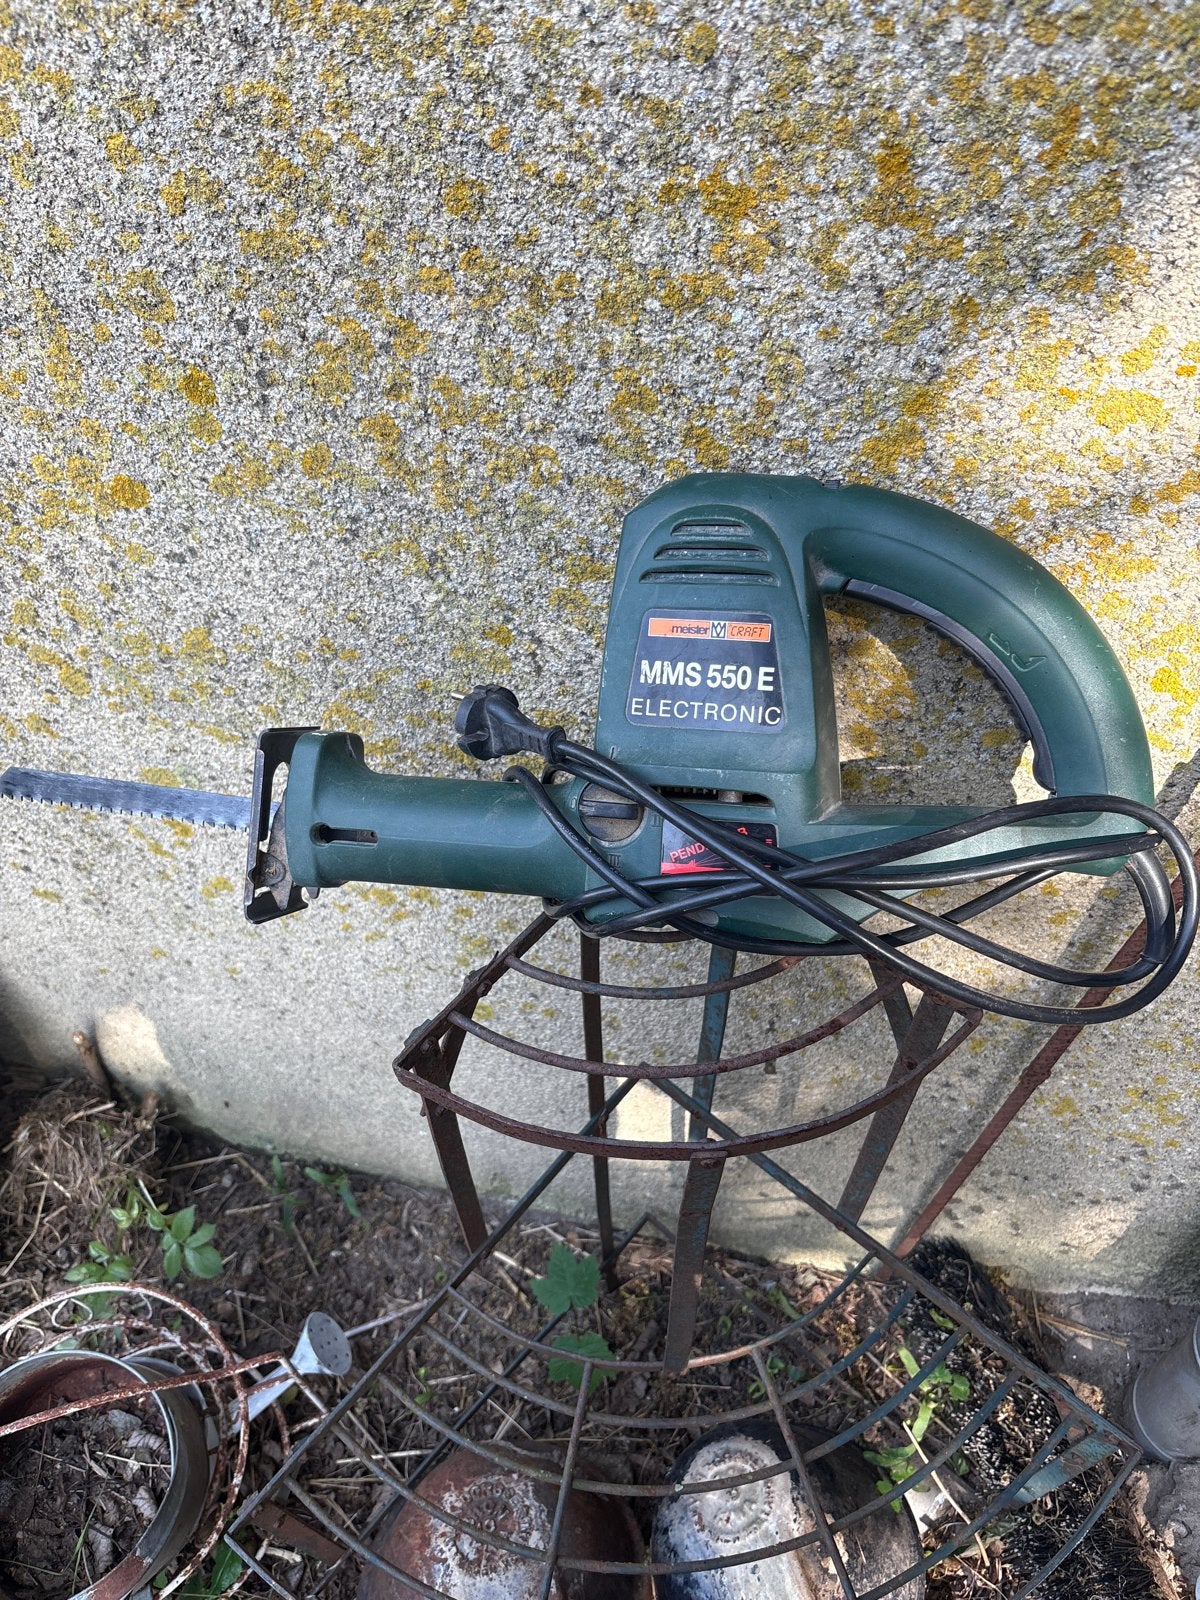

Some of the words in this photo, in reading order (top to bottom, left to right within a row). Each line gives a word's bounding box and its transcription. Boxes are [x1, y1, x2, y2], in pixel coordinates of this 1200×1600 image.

[671, 624, 710, 636] meister
[729, 625, 765, 638] CRAFT
[639, 659, 701, 687] MMS
[706, 664, 752, 690] 550
[757, 666, 775, 692] E
[631, 697, 781, 725] ELECTRONIC
[669, 842, 709, 862] PEND
